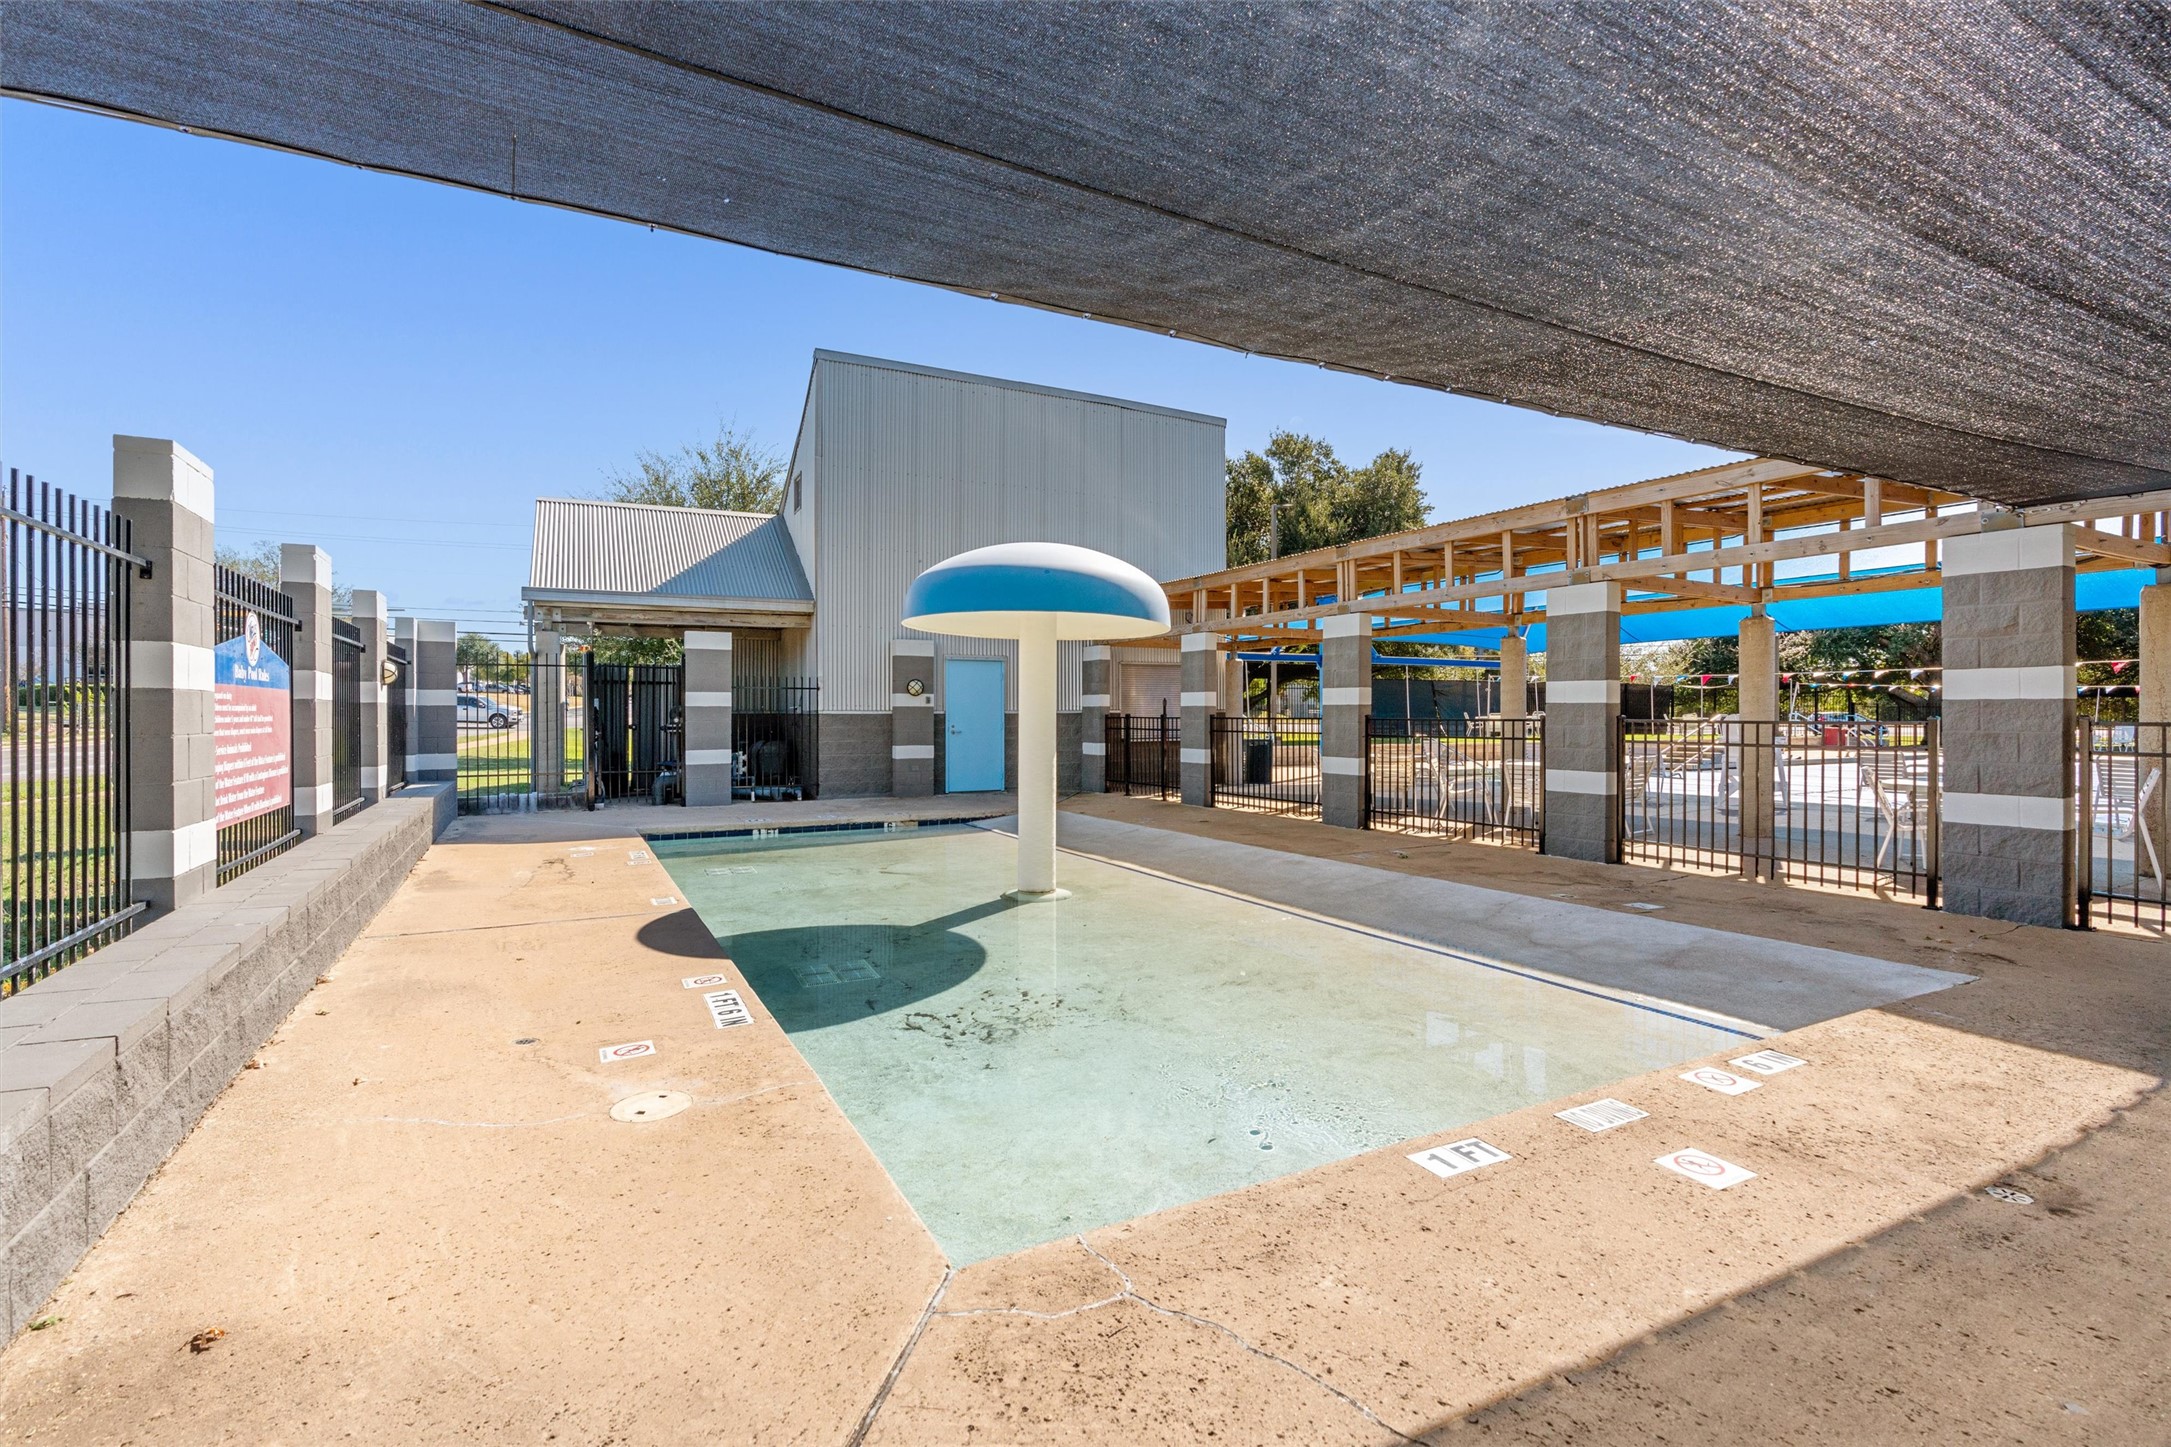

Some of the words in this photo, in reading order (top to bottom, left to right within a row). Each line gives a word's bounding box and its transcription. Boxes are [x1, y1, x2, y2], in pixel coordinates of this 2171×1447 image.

[234, 663, 247, 683] Baby
[247, 665, 258, 680] Pool
[258, 668, 270, 682] Rules
[712, 998, 739, 1008] FT
[720, 1015, 748, 1027] IN
[1742, 1060, 1773, 1070] 6
[1757, 1052, 1800, 1066] IN
[1427, 1153, 1458, 1169] 1
[1450, 1141, 1500, 1163] FT
